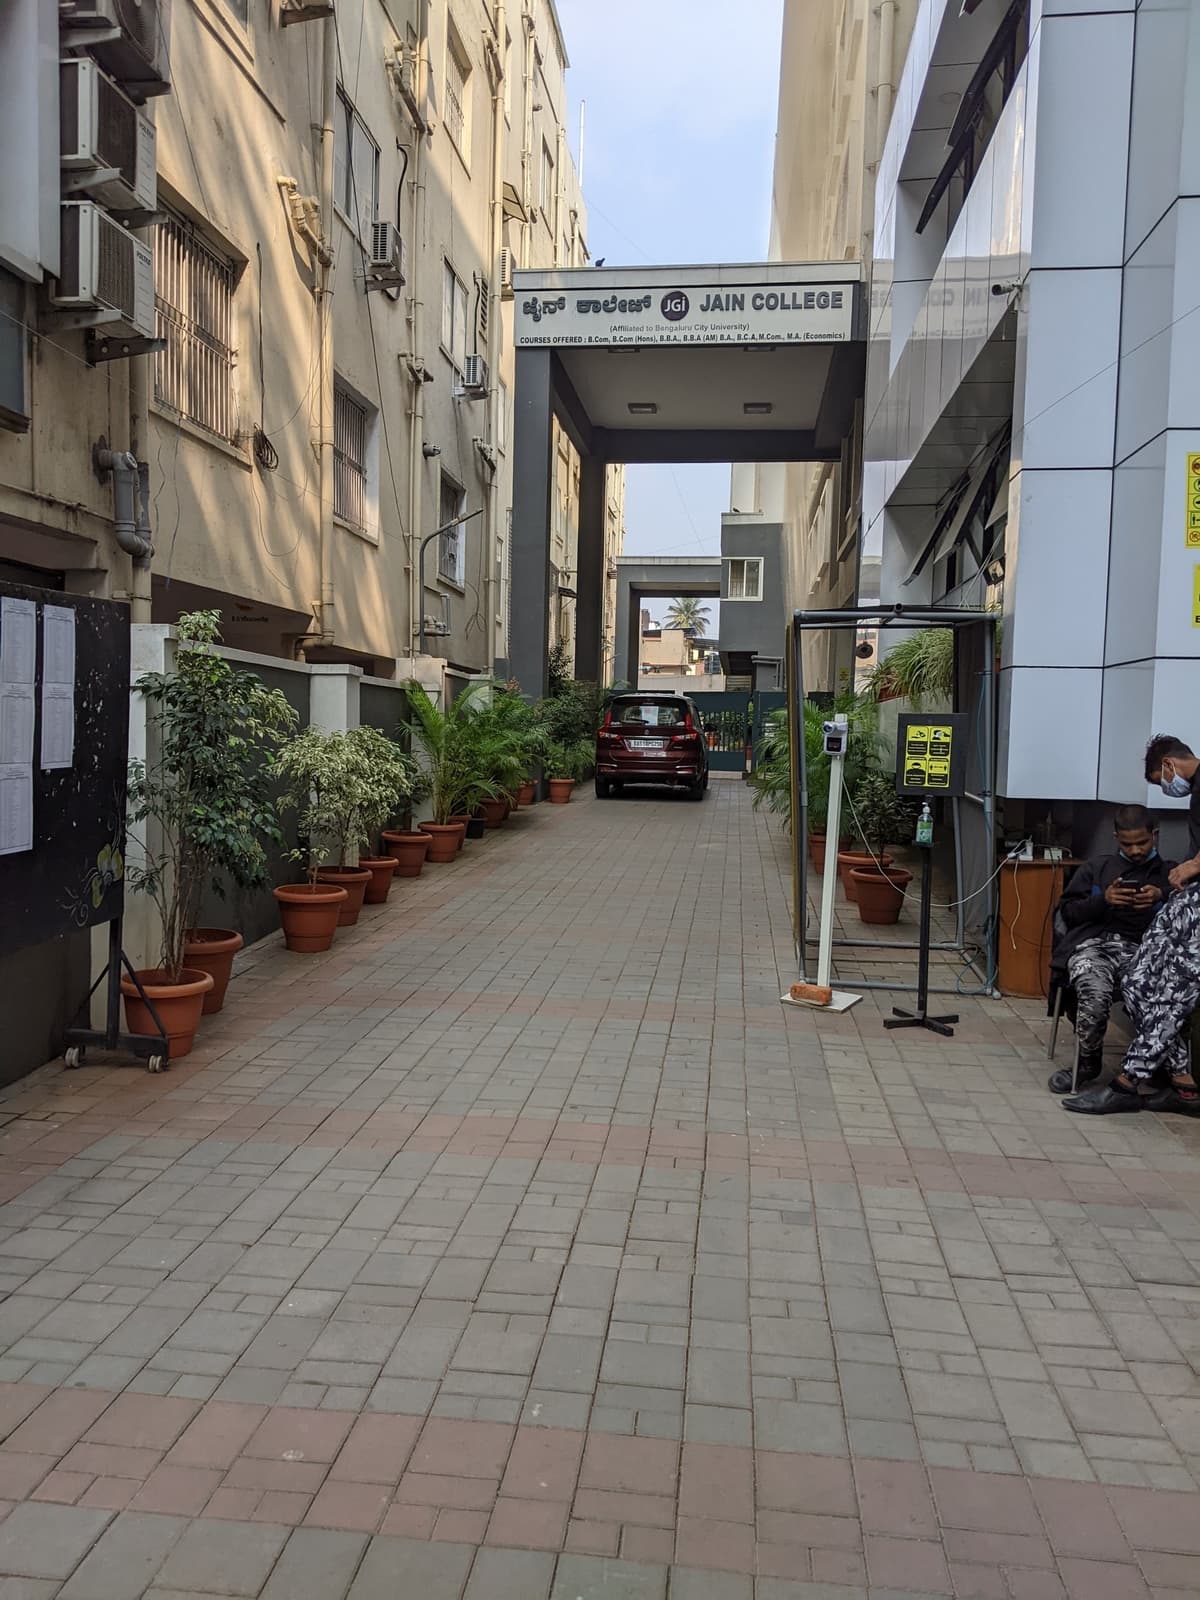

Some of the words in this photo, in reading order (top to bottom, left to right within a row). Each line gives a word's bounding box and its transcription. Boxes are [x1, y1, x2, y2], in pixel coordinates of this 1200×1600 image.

[522, 296, 566, 322] ಜೈನ್
[576, 295, 651, 313] ಕಾಲೇಜ್
[700, 293, 745, 312] JAIN
[752, 291, 843, 311] COLLEGE
[610, 325, 644, 333] (Affiliated
[655, 324, 692, 332] Bengaluru
[694, 324, 709, 332] City
[710, 323, 750, 332] University)
[703, 334, 718, 342] (AM)
[803, 332, 845, 341] (Economics)
